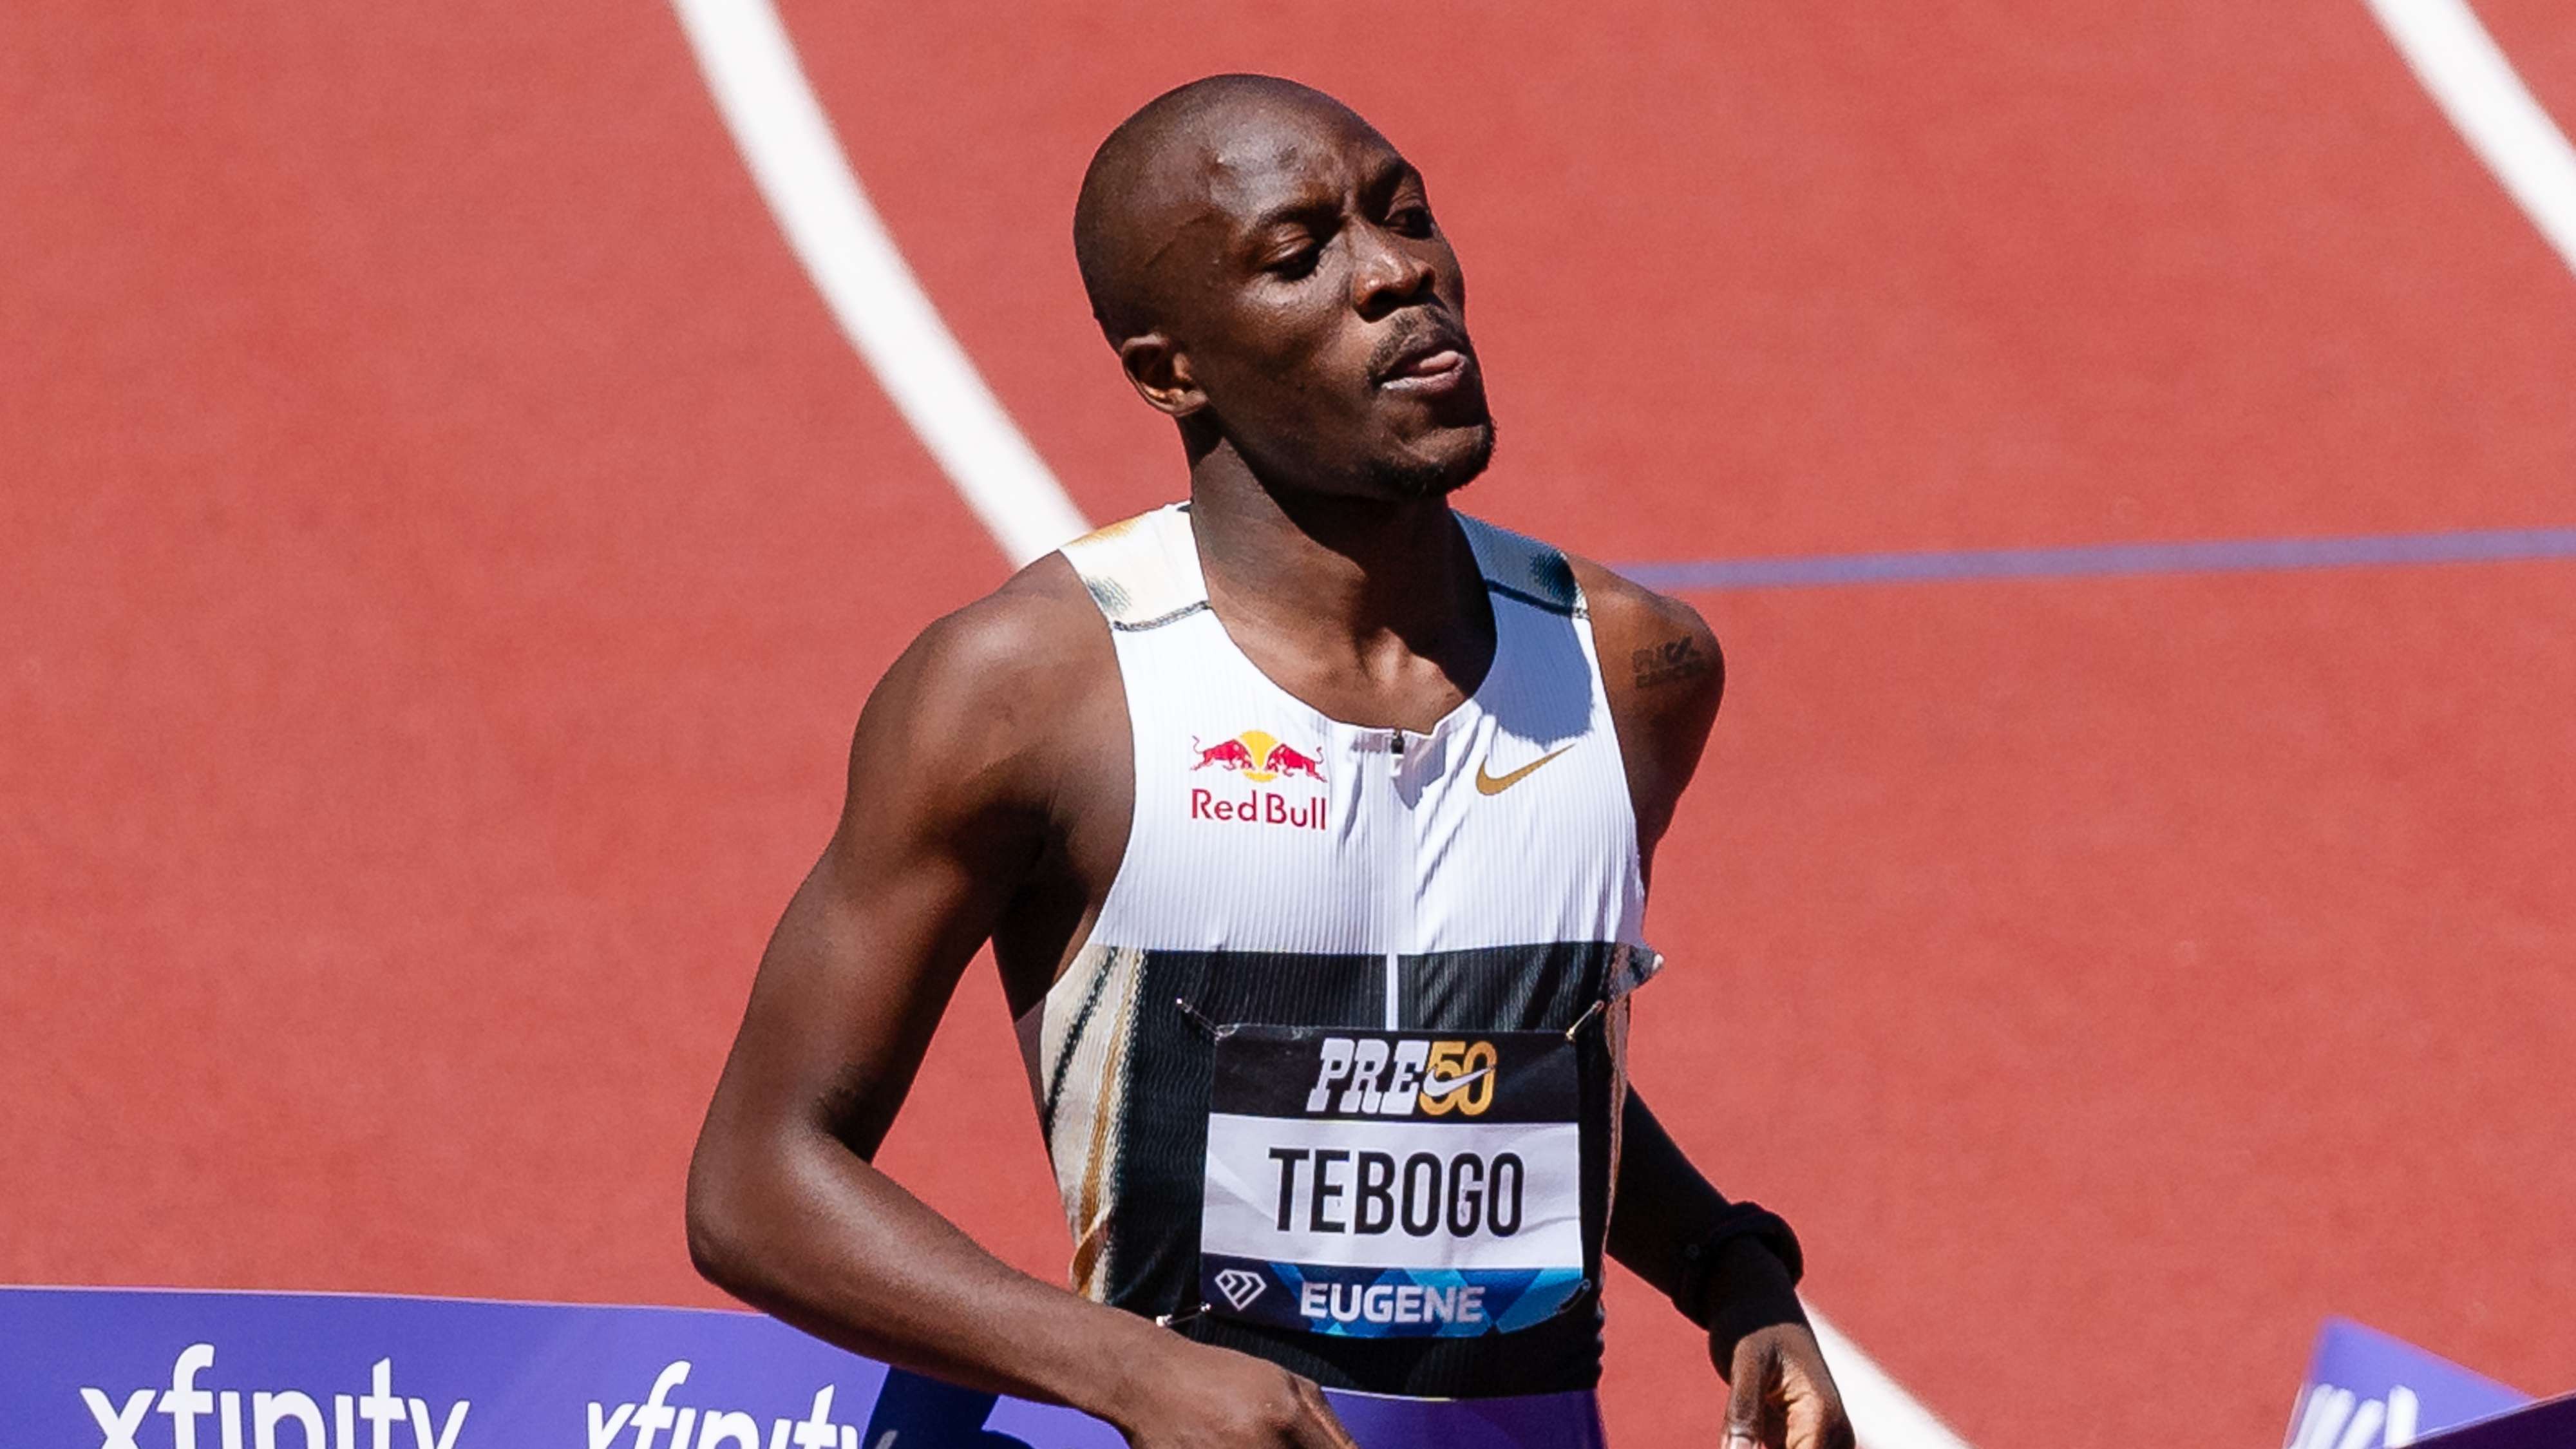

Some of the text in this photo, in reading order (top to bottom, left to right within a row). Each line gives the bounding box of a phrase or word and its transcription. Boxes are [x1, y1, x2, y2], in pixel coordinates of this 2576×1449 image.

[1190, 788, 1326, 830] Red Bull
[1268, 1147, 1524, 1238] TEBOGO
[1300, 1282, 1486, 1324] EUGENE
